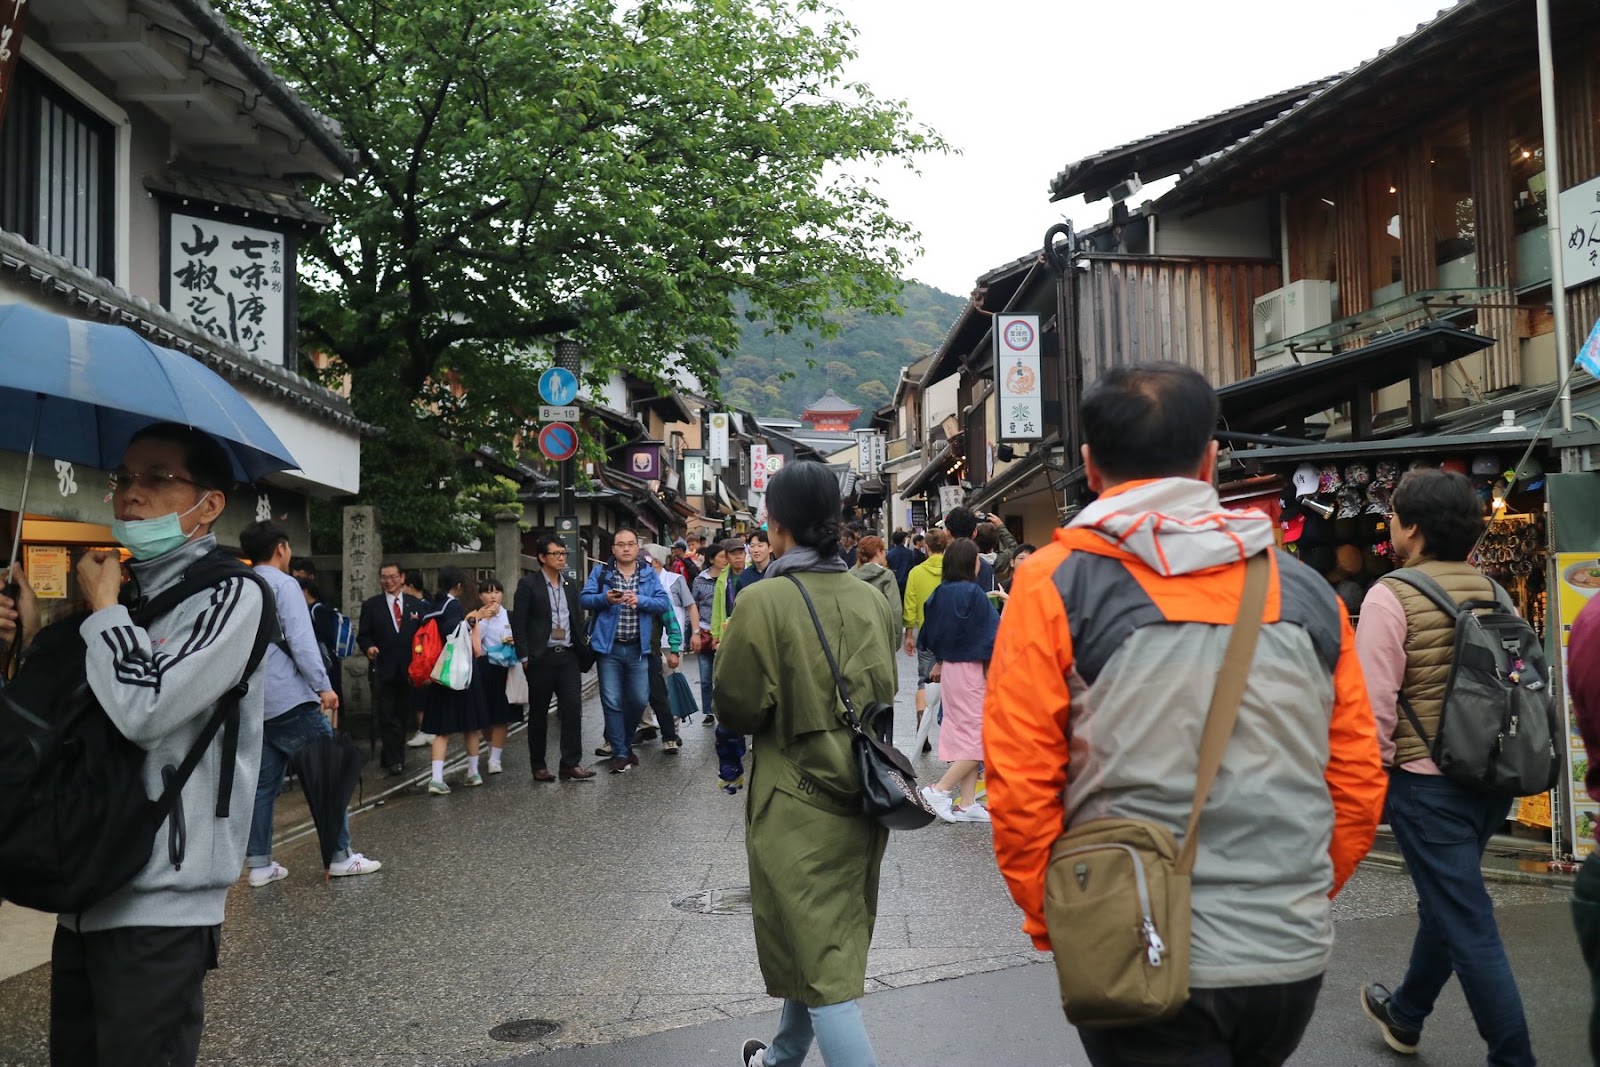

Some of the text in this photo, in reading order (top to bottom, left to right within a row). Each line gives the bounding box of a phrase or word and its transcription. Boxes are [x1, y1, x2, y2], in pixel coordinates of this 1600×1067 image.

[270, 237, 282, 293] 京名物
[1009, 421, 1035, 433] 豆政
